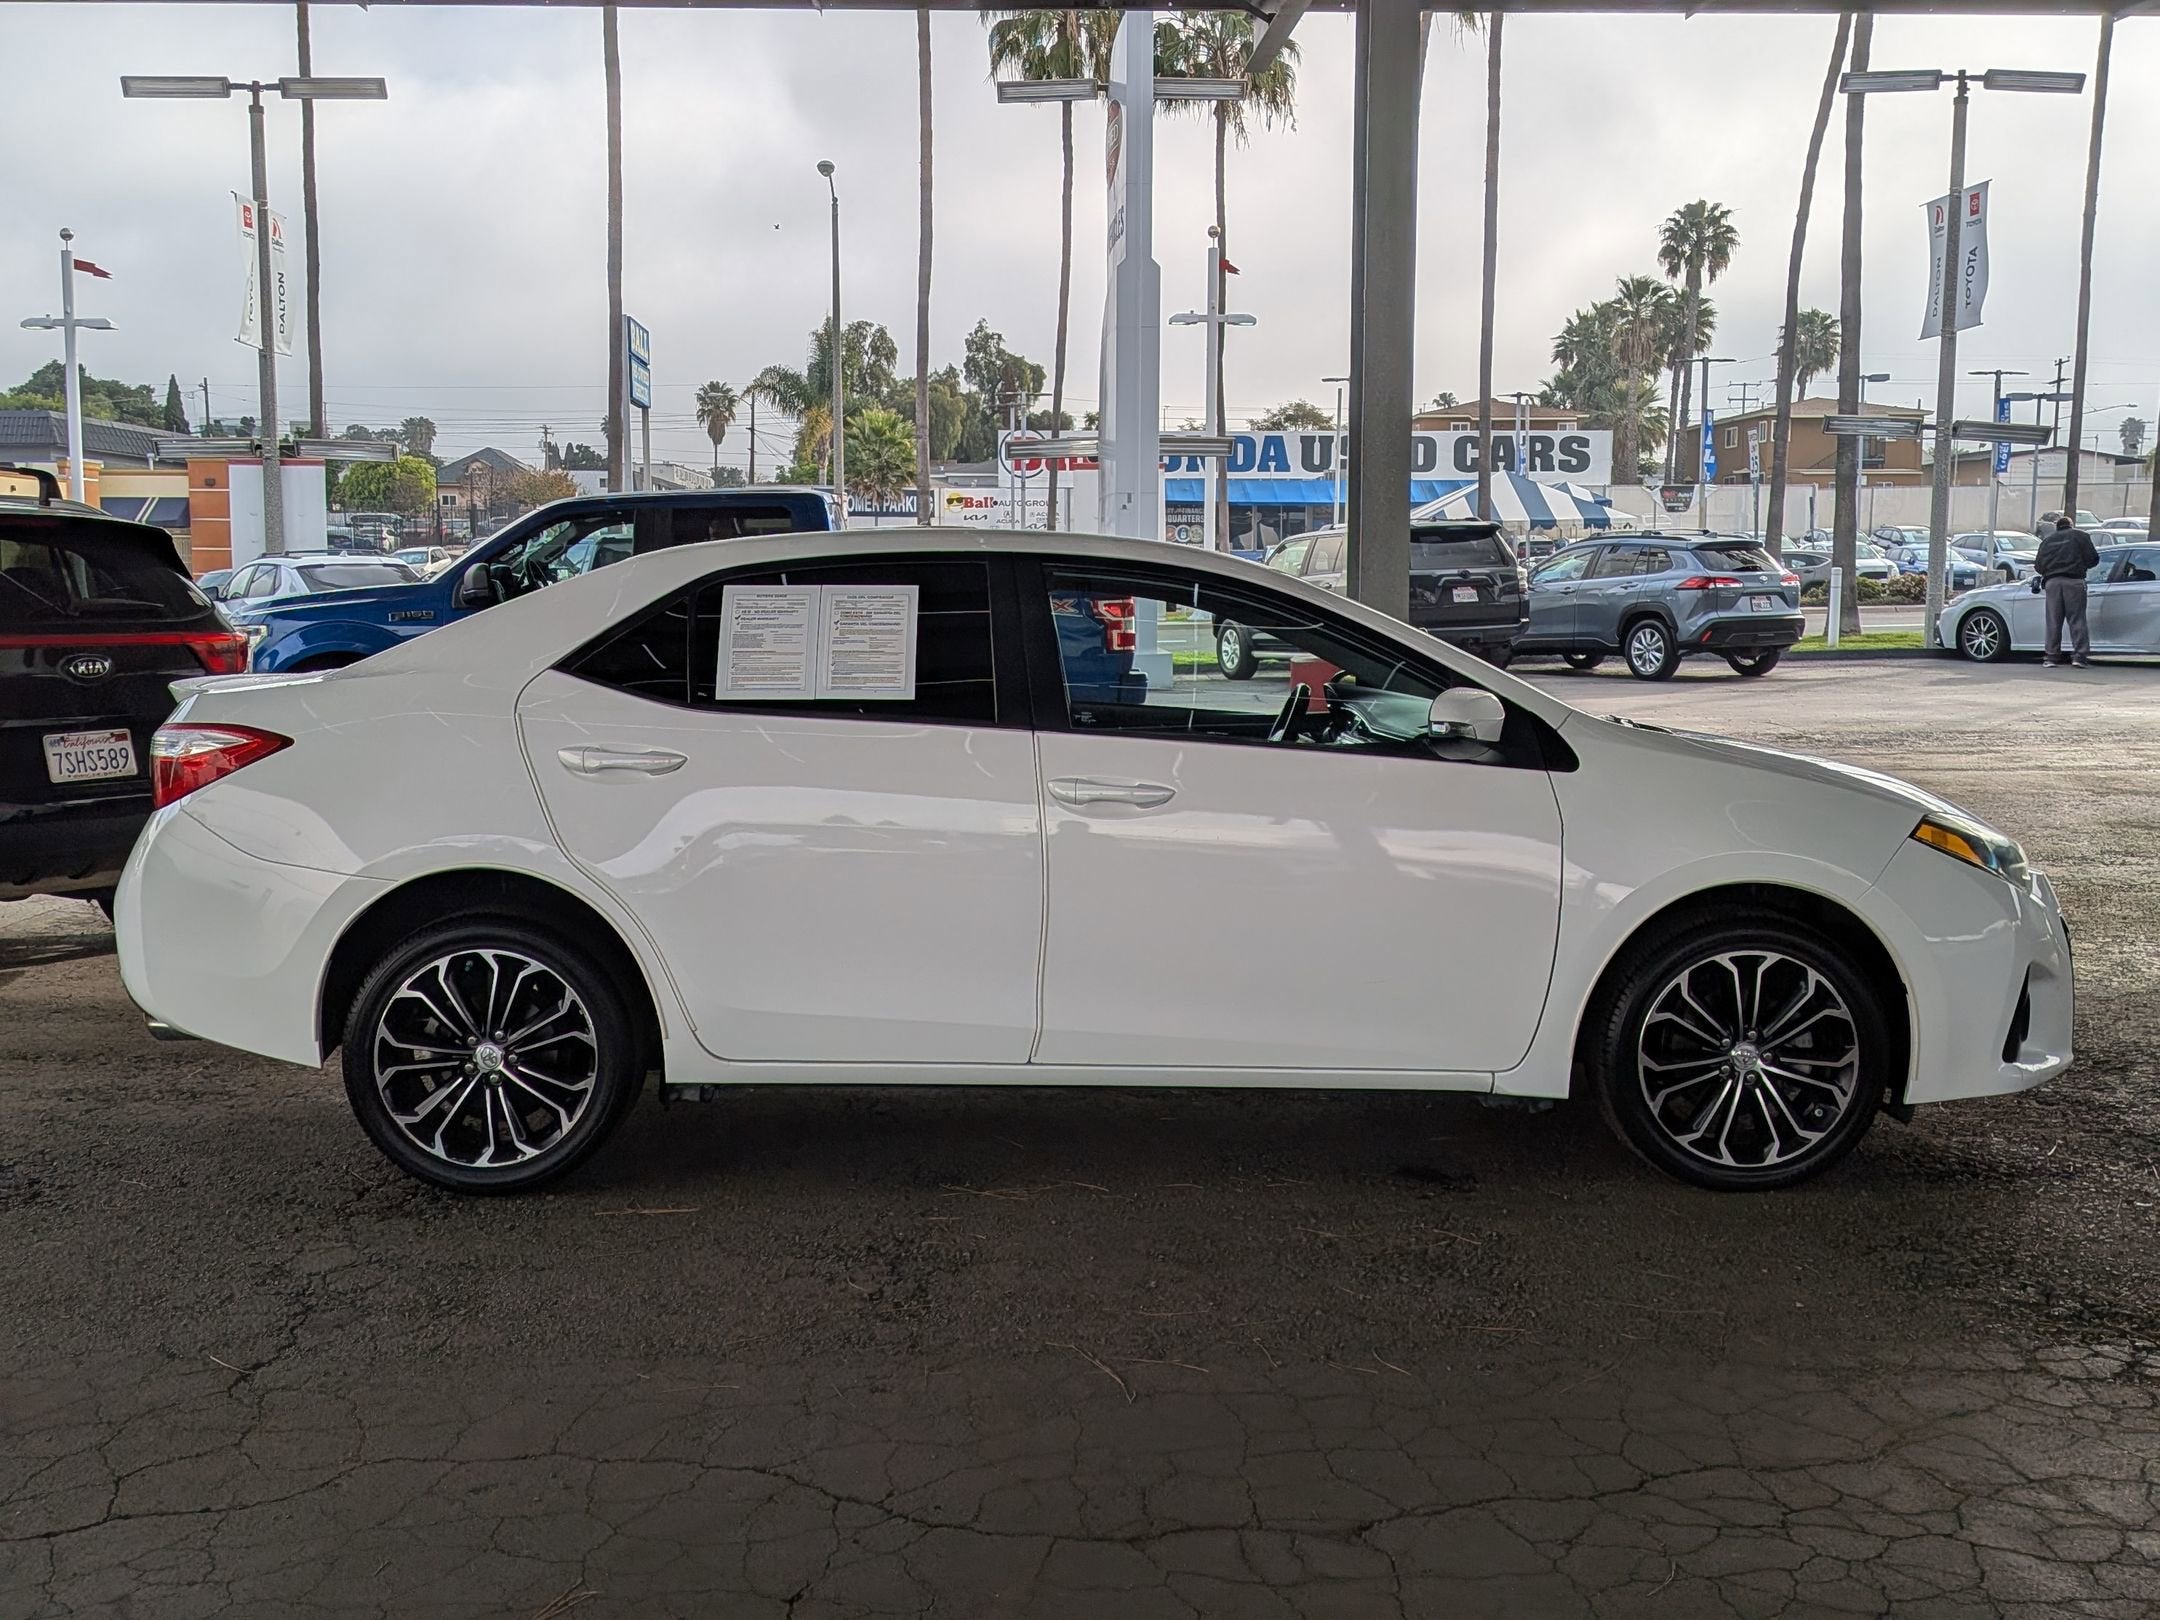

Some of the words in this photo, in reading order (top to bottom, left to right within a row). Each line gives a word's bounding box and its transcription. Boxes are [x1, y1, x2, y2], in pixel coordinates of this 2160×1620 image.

[1932, 257, 1942, 317] DALTON
[1965, 246, 1978, 309] TOYOTA
[277, 272, 285, 334] DALTON
[1454, 435, 1591, 473] CARS
[77, 661, 104, 674] KIA
[52, 747, 130, 775] 7SHS589
[63, 734, 116, 750] California
